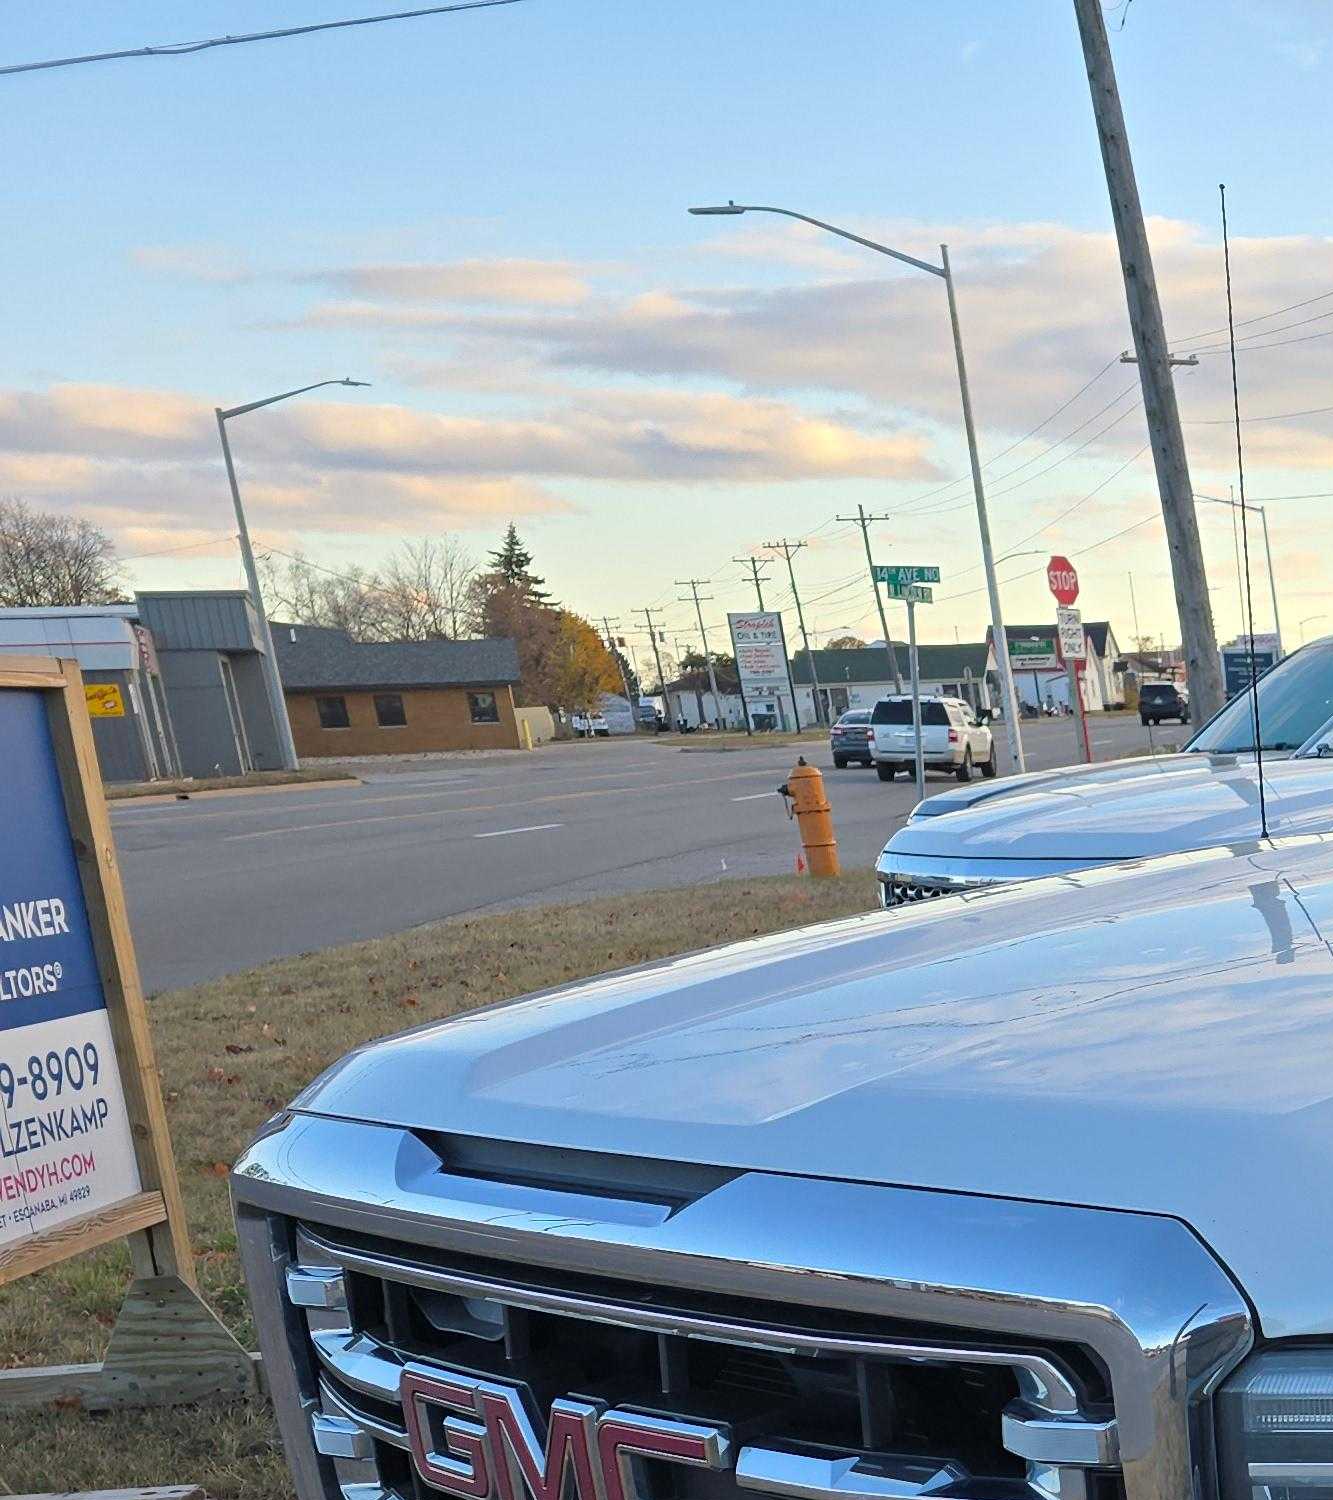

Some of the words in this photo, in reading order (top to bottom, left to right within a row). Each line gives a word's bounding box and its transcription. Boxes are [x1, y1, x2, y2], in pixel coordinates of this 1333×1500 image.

[898, 567, 921, 582] AVE
[1049, 570, 1077, 591] STOP
[0, 1042, 100, 1109] 9-8909
